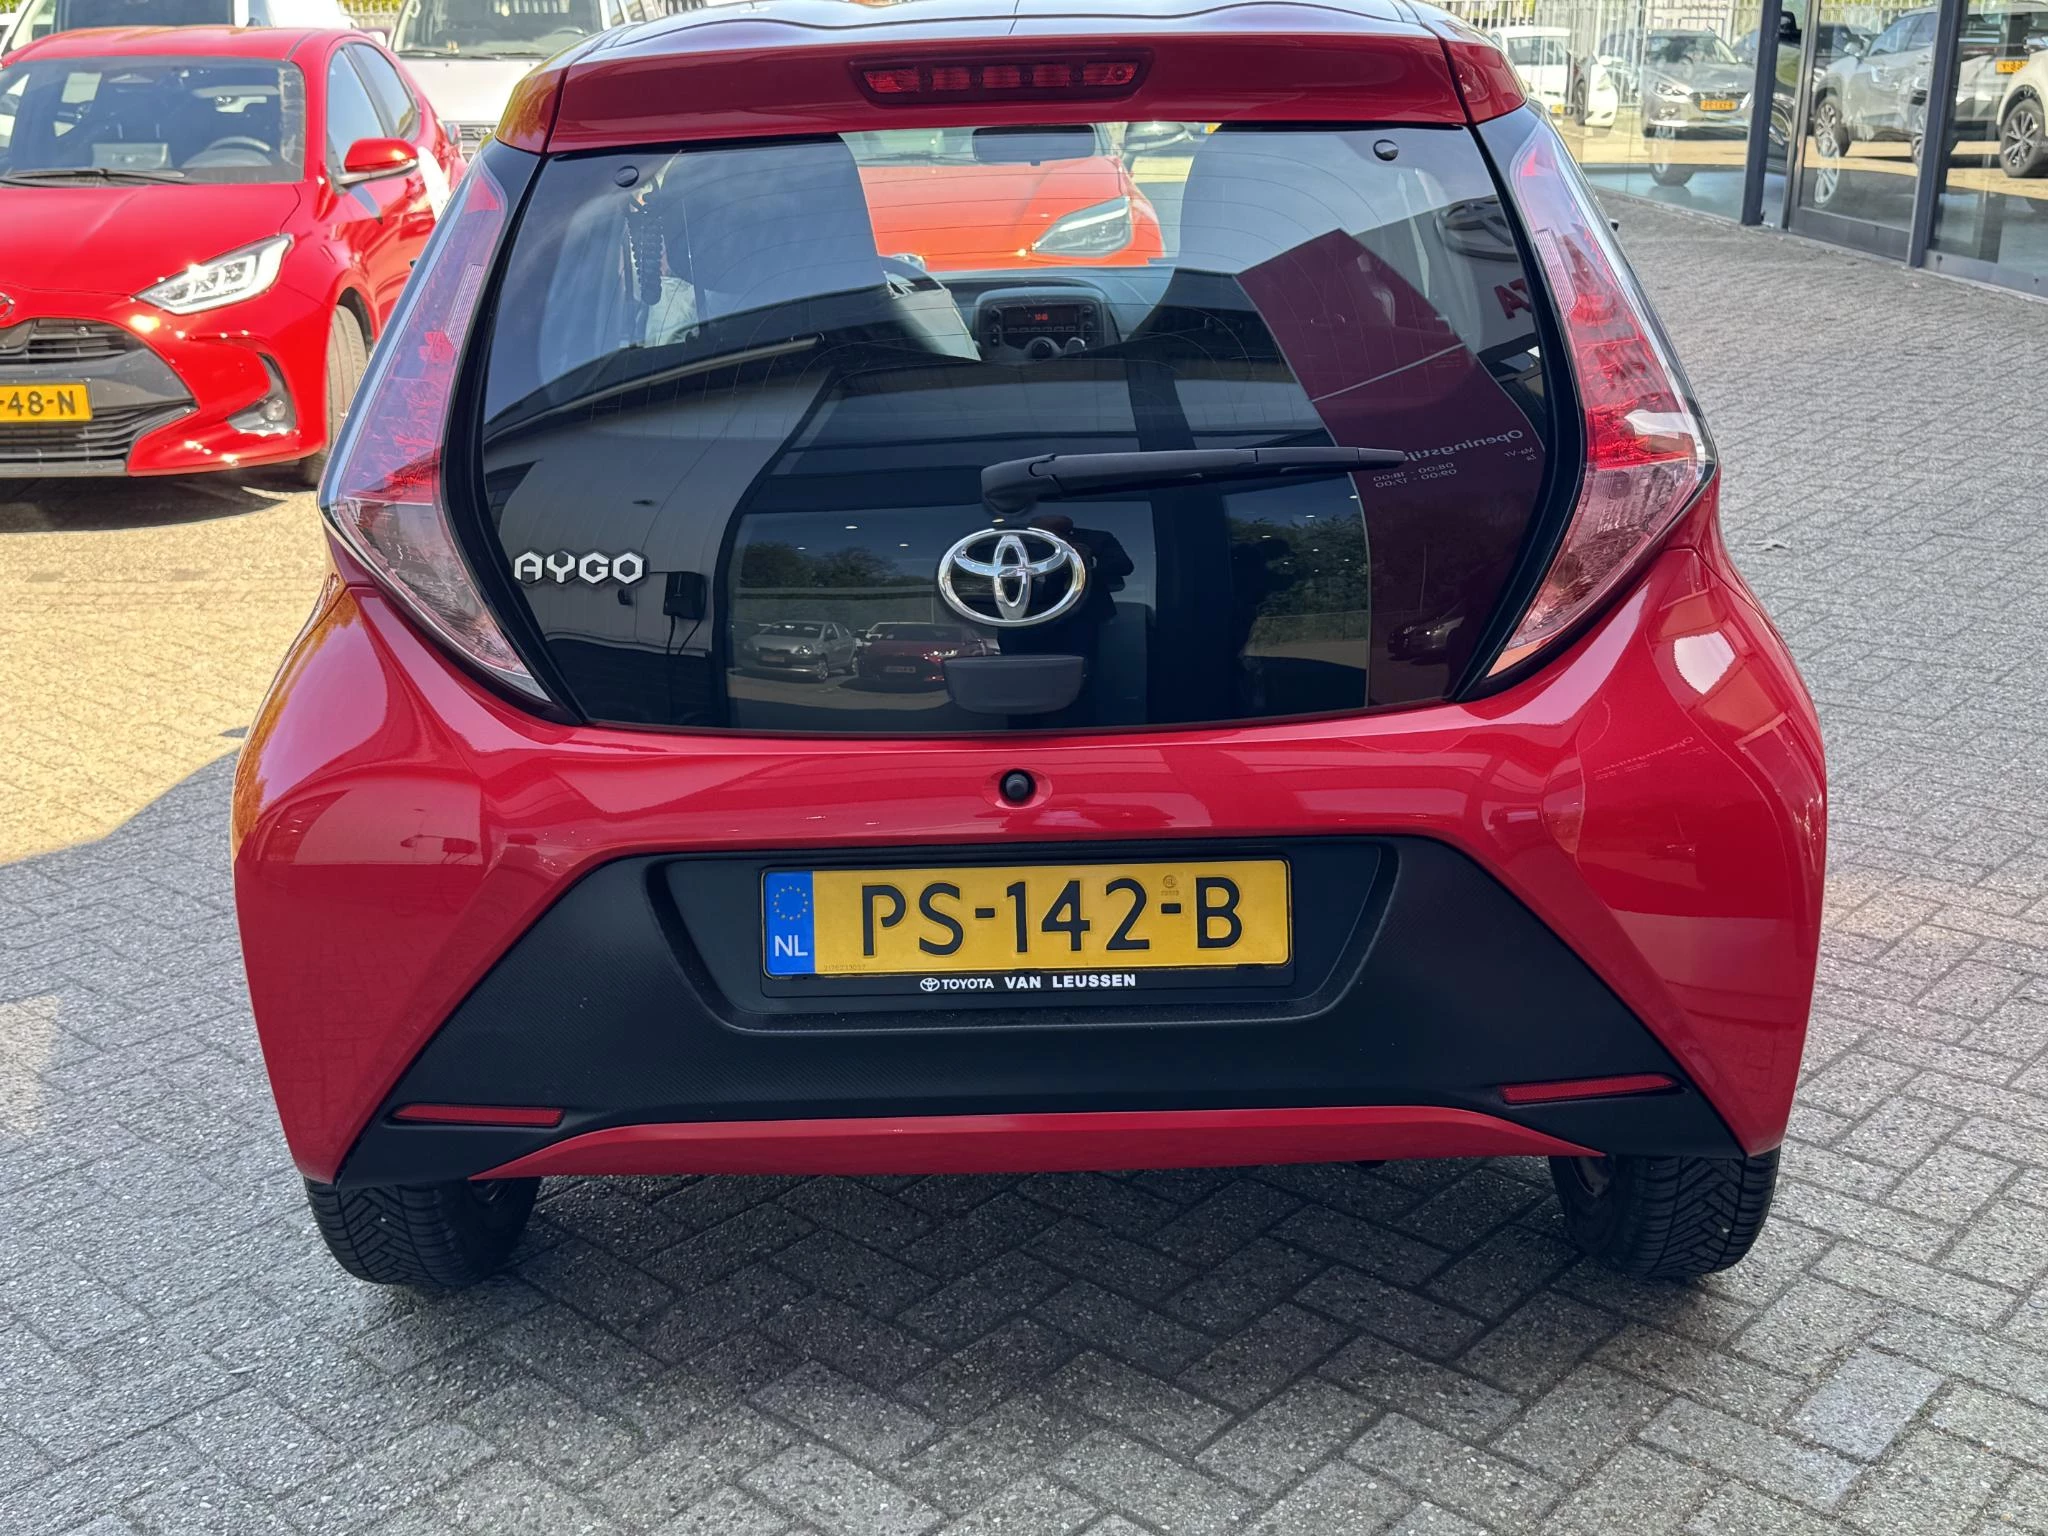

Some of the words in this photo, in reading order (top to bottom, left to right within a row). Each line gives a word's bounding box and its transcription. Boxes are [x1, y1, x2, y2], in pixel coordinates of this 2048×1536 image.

[514, 551, 645, 584] AYGO
[861, 876, 1242, 957] PS-142-B
[774, 934, 809, 957] NL
[941, 978, 995, 990] TOYOTA
[1004, 976, 1041, 989] VAN
[1052, 974, 1136, 988] LEUSSEN
